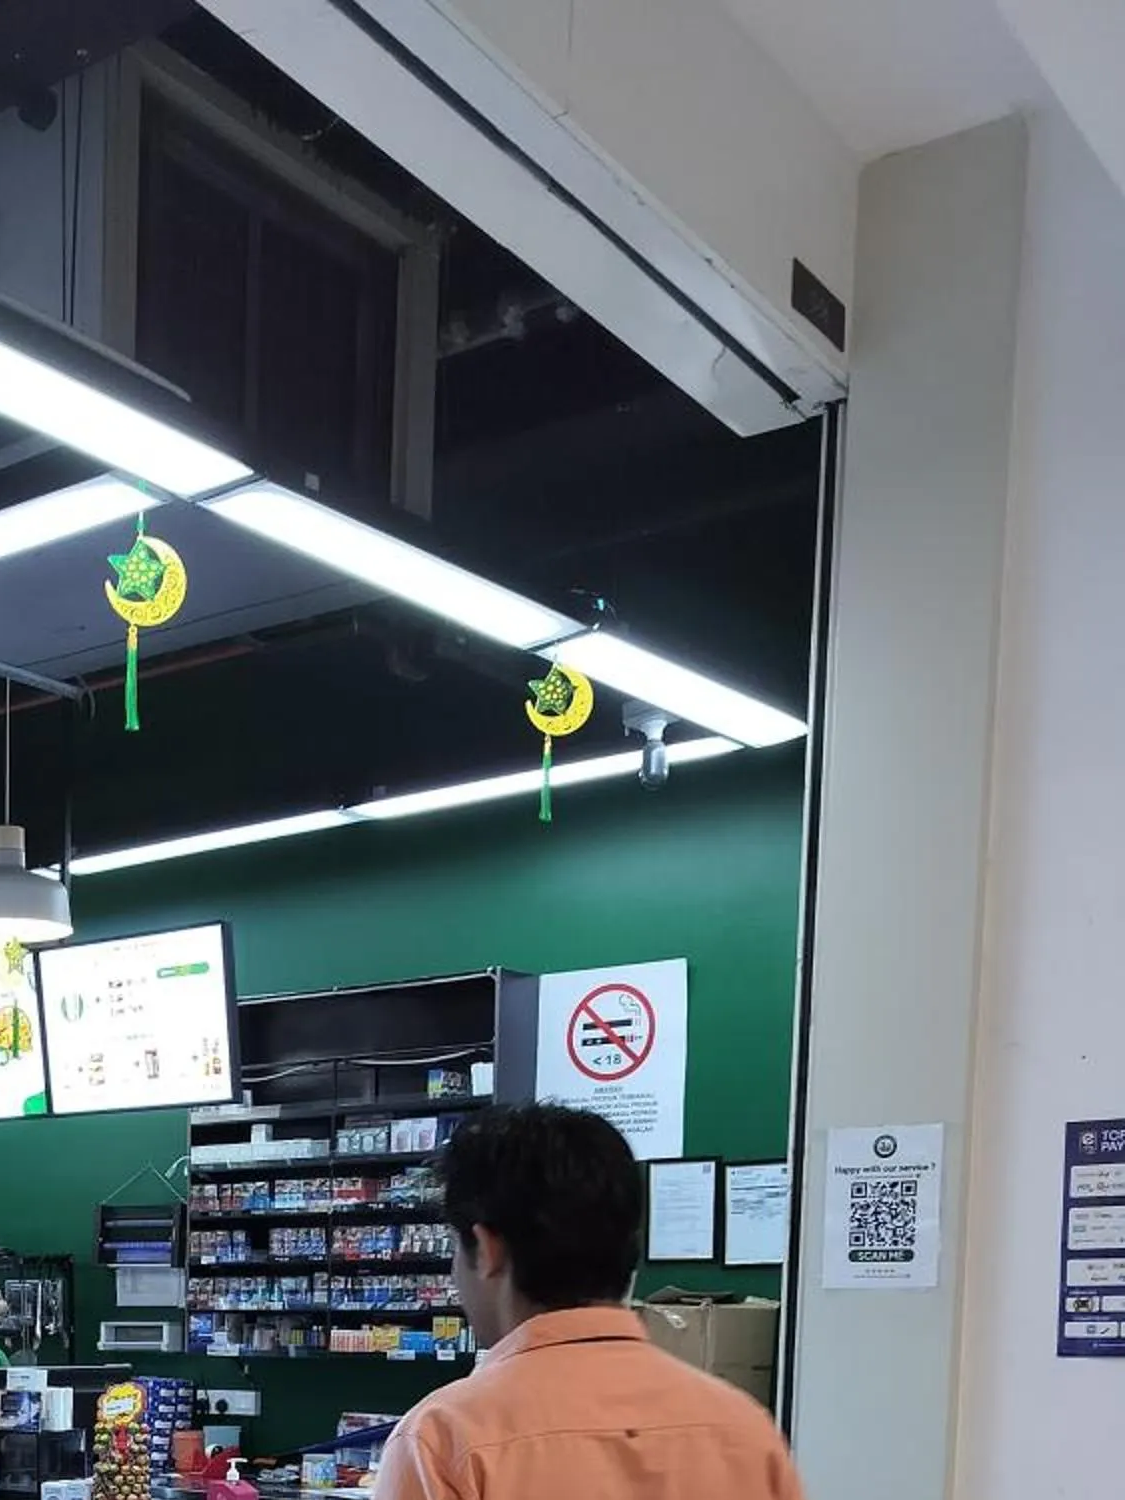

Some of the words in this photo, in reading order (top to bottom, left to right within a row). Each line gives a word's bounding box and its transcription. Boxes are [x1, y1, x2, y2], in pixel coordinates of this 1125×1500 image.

[835, 1166, 861, 1175] Happy
[863, 1165, 880, 1173] with
[858, 1251, 886, 1261] SCAN
[889, 1251, 903, 1260] ME
